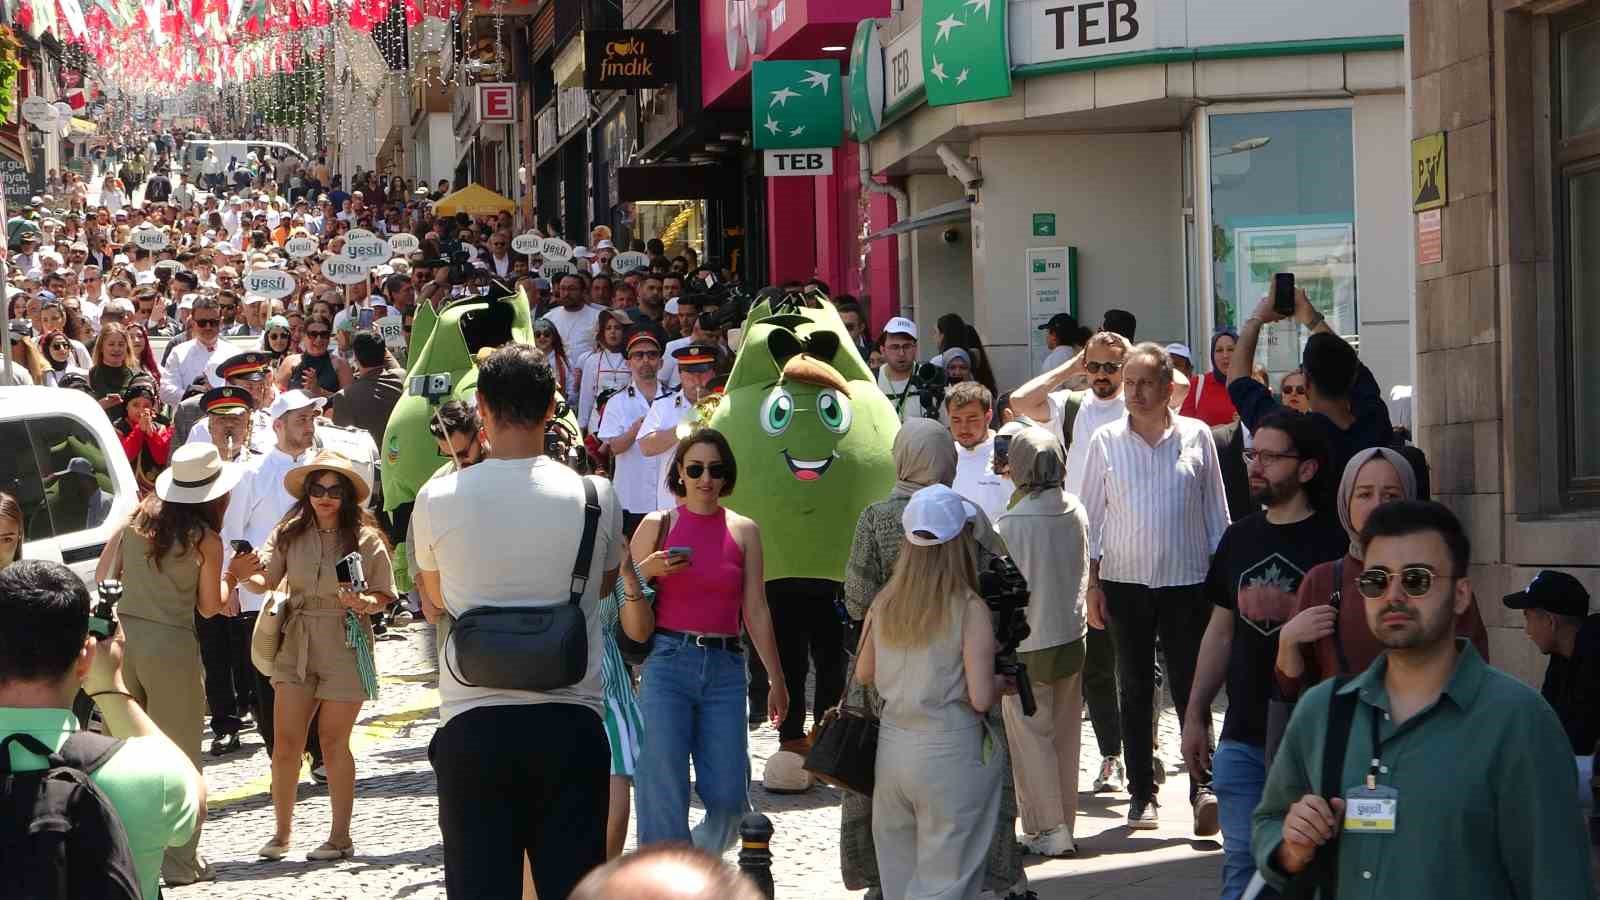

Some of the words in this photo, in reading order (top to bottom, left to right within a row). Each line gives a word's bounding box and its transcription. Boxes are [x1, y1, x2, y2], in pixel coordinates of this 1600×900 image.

[1045, 0, 1140, 50] TEB
[892, 48, 909, 97] TEB
[487, 91, 509, 115] E
[773, 153, 824, 171] TEB
